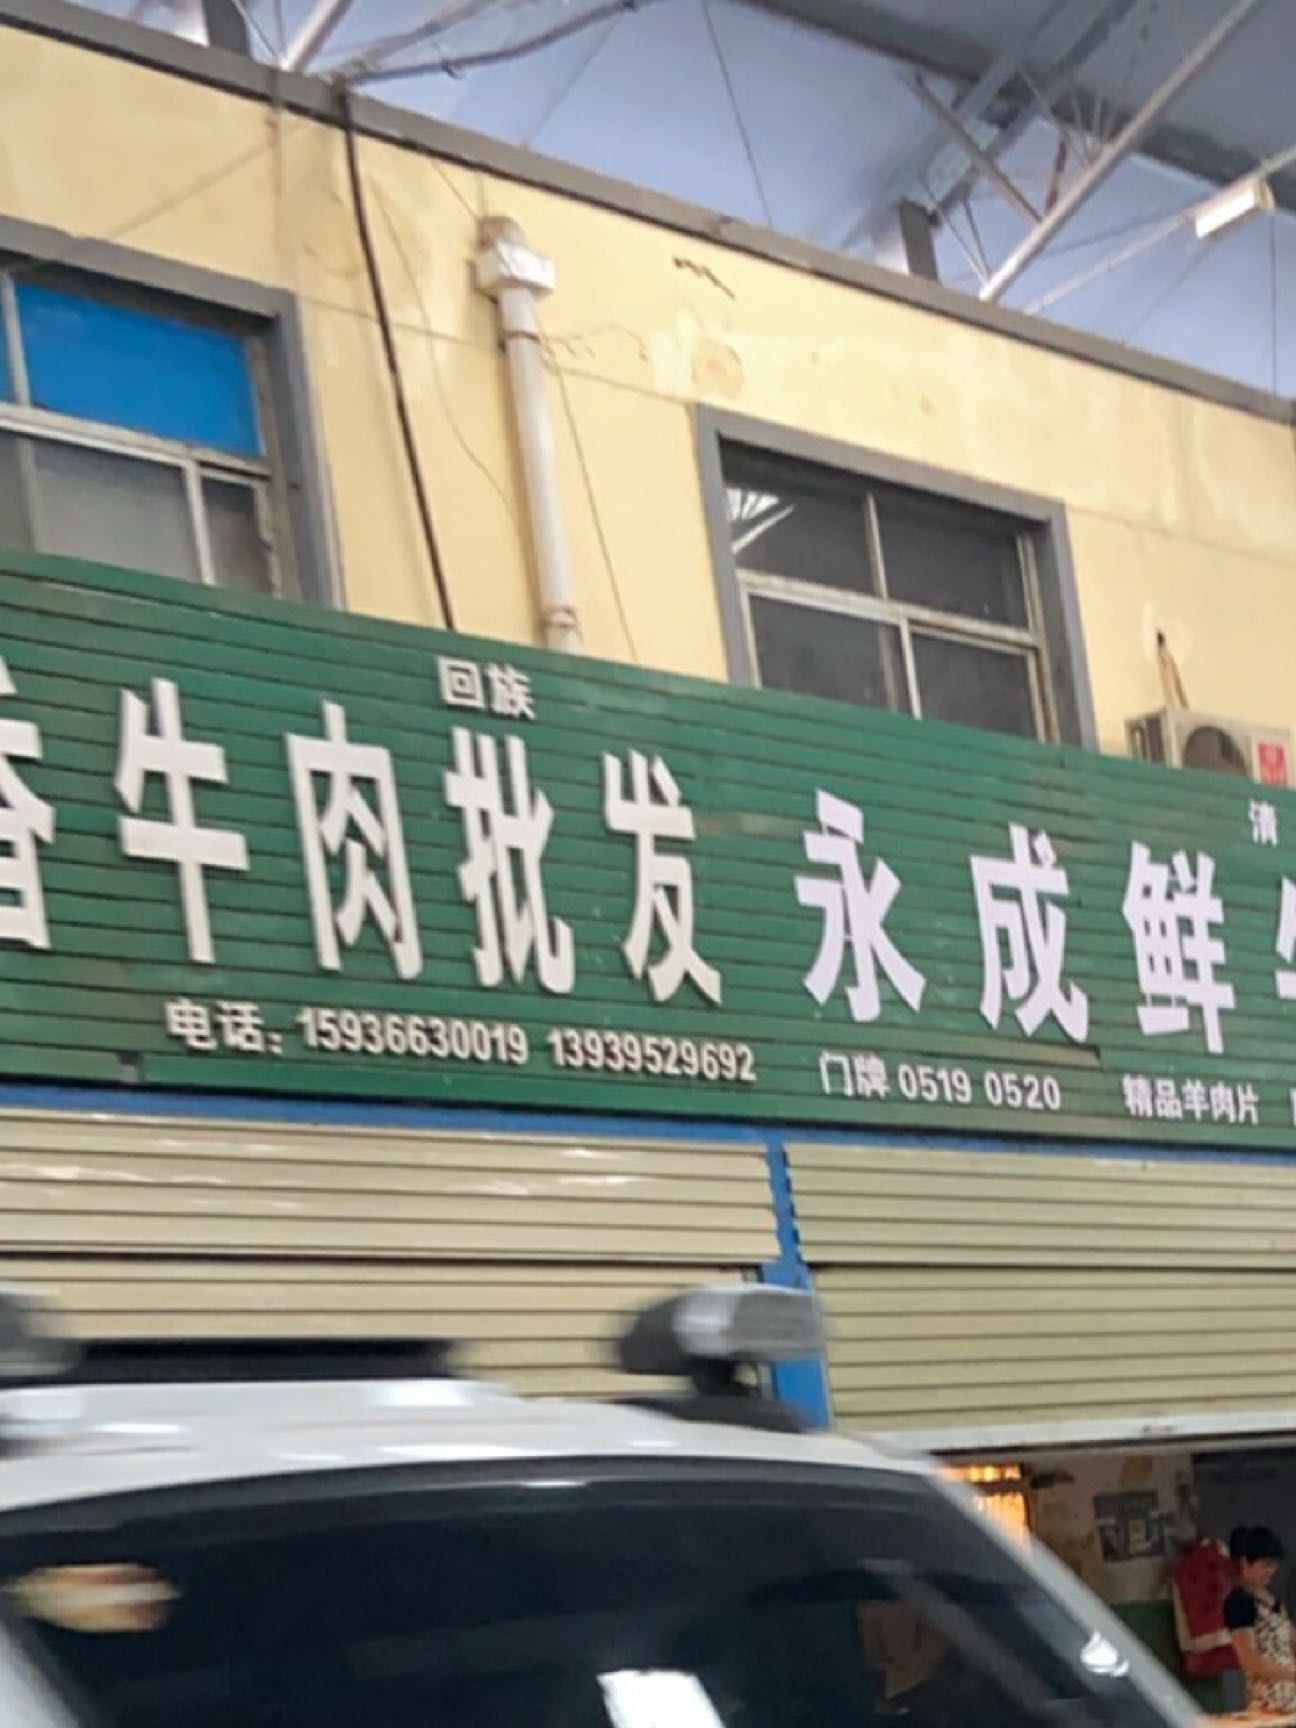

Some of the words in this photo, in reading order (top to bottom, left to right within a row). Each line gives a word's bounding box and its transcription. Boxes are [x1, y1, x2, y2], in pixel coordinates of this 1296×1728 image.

[434, 655, 537, 720] 回族
[296, 1008, 530, 1066] 15936630019
[546, 1027, 758, 1083] 13939529692
[818, 1050, 890, 1098] 门牌
[898, 1063, 972, 1105] 0519
[985, 1070, 1062, 1111] 0520
[1122, 1074, 1260, 1126] 精品羊肉片
